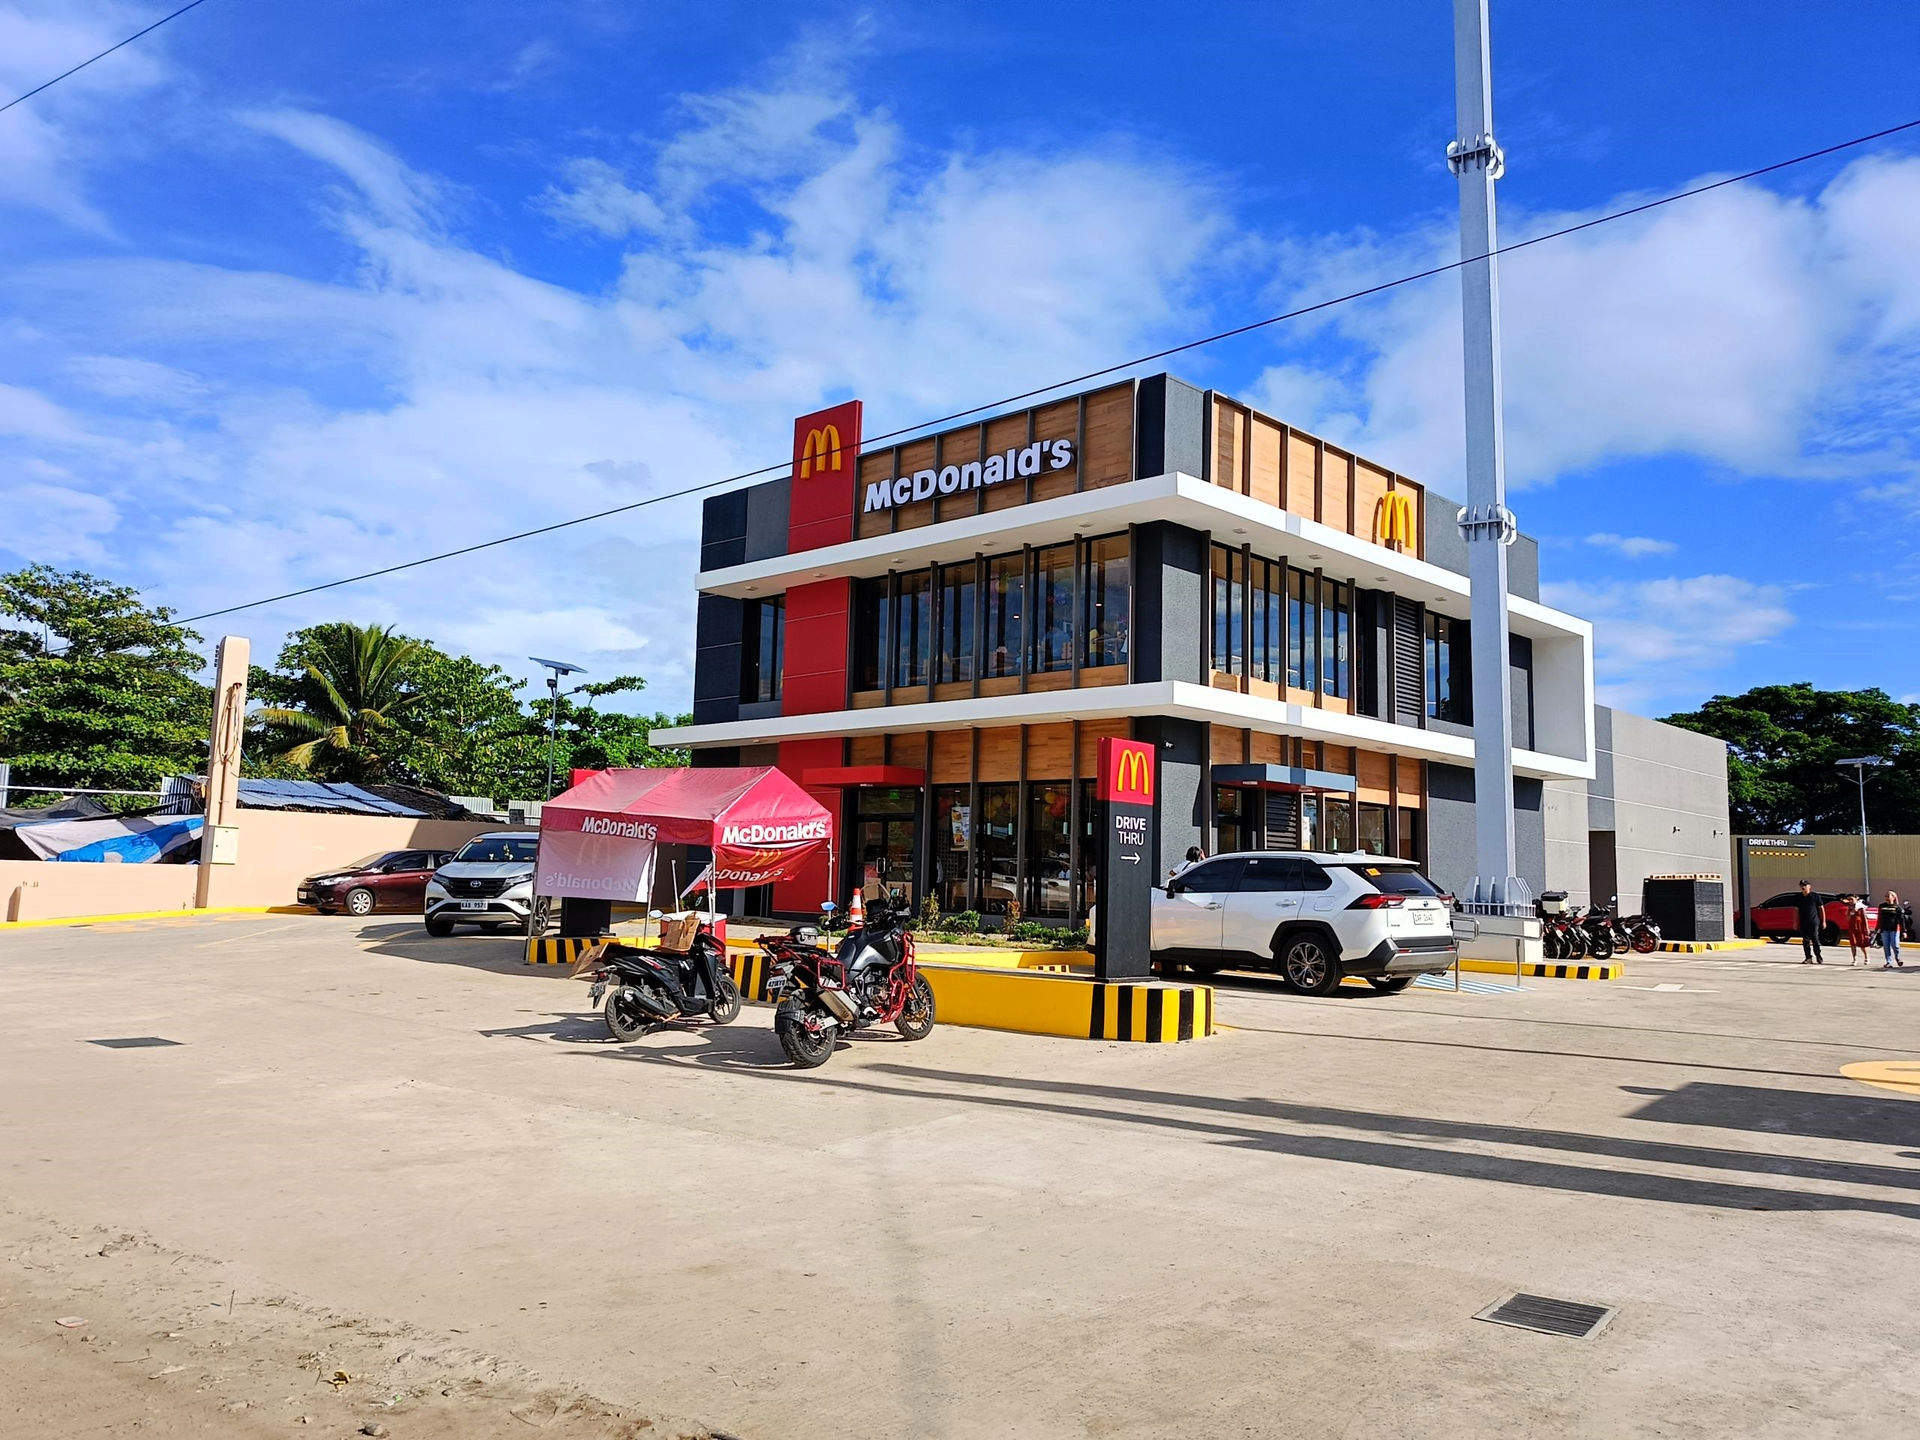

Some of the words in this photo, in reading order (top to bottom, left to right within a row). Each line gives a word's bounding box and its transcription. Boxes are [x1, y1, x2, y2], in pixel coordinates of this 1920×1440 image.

[865, 439, 1072, 513] McDonald's
[581, 816, 657, 841] McDonald's
[721, 821, 827, 844] McDonald's
[1115, 815, 1146, 831] DRIVE
[1118, 830, 1144, 846] THRU
